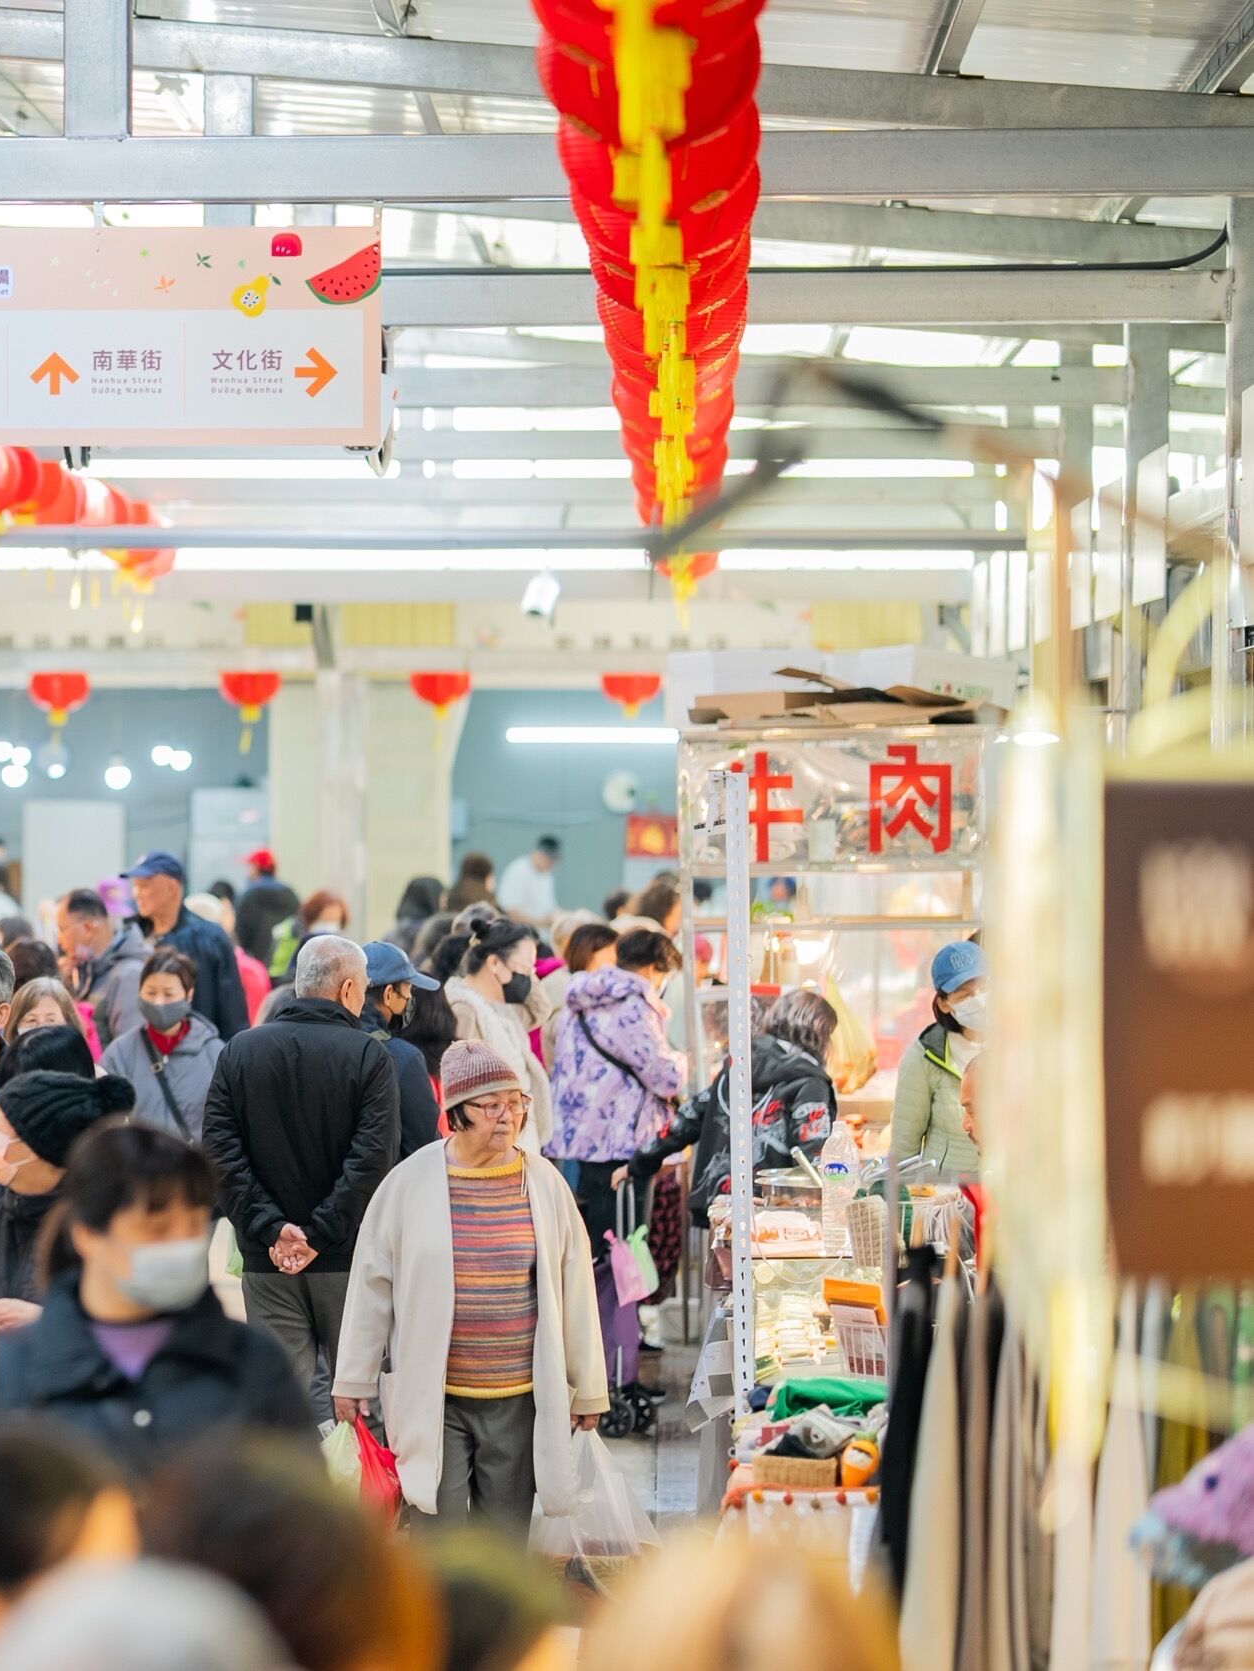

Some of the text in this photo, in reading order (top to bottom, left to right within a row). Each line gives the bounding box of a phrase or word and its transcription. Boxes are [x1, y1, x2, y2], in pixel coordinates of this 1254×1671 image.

[92, 349, 162, 371] 南華街
[212, 349, 283, 371] 文化街
